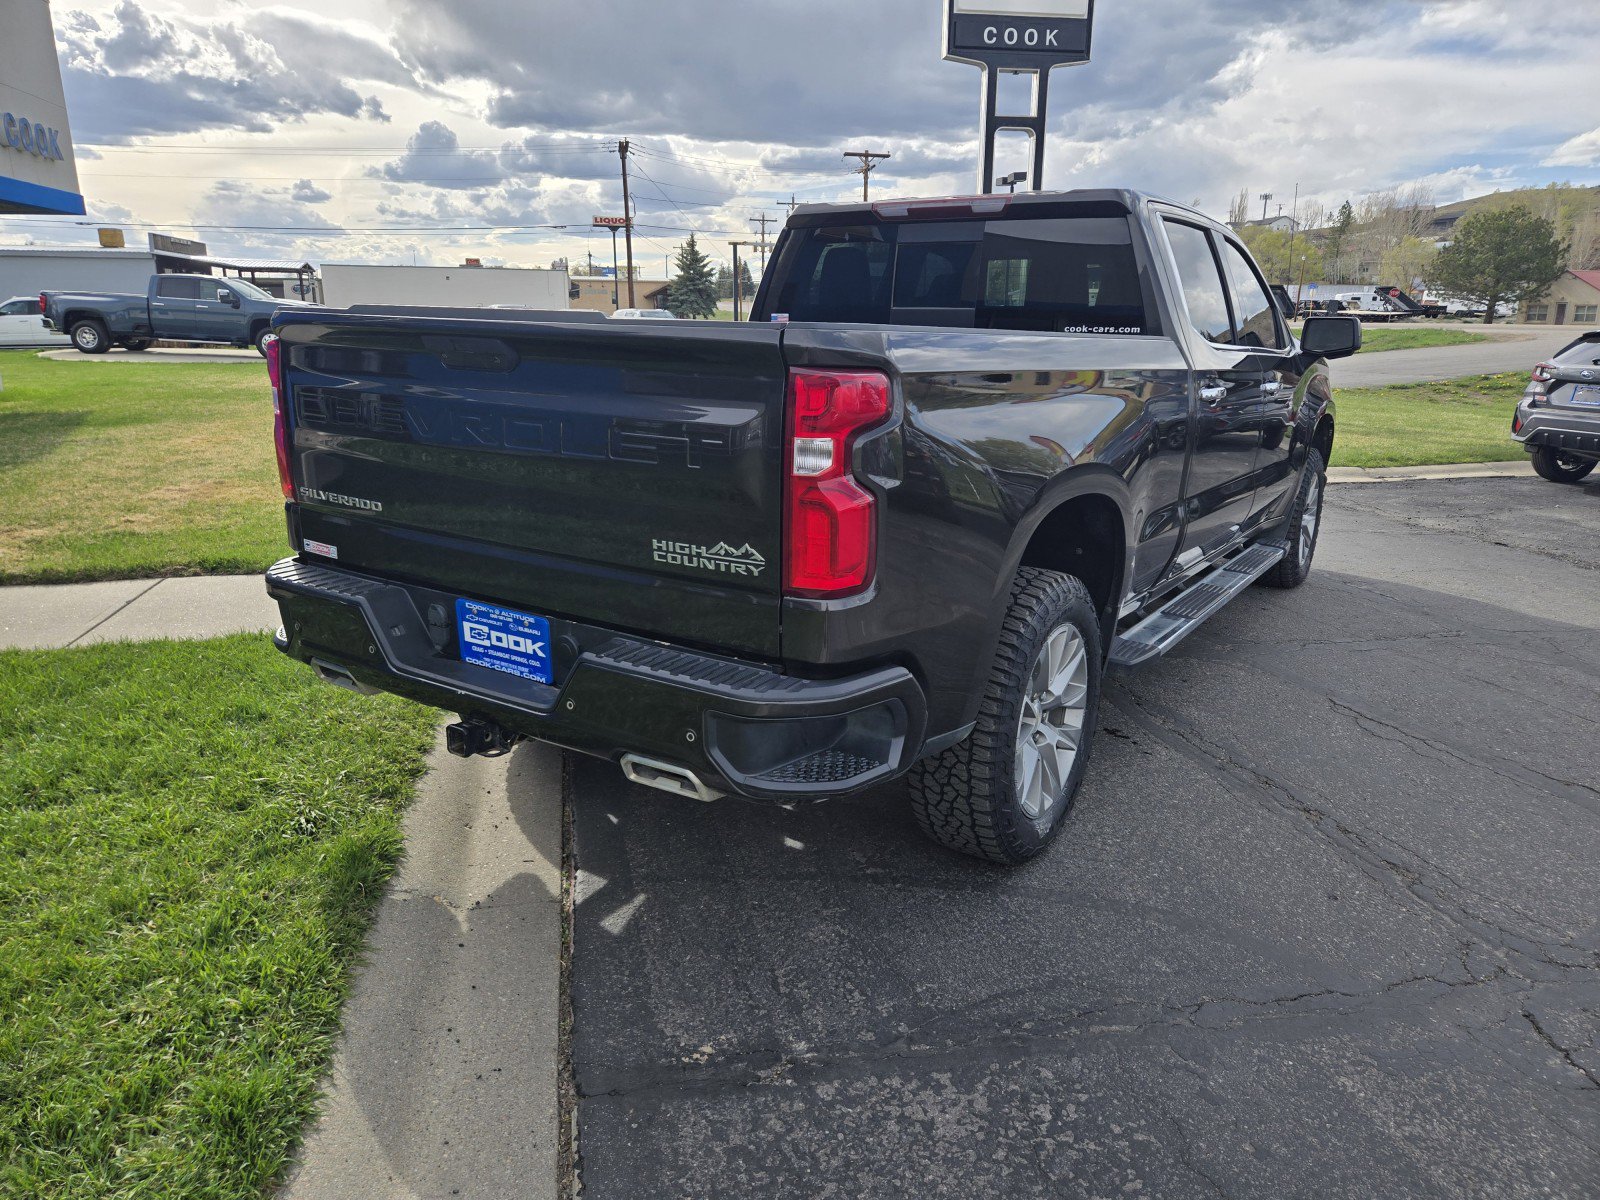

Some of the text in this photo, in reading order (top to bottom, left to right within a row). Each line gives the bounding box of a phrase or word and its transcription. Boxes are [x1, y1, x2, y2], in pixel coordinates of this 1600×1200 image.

[983, 26, 1059, 47] COOK
[3, 112, 64, 161] COOK
[1064, 324, 1141, 334] cook-cars.com
[297, 386, 735, 468] CHEVROLET
[300, 486, 382, 511] SILVERADO
[652, 539, 707, 556] HIGH
[653, 551, 765, 577] COUNTRY
[502, 612, 535, 623] ALTITUDE
[518, 627, 541, 636] SUBARU
[465, 657, 546, 683] COOK-CARS.COM
